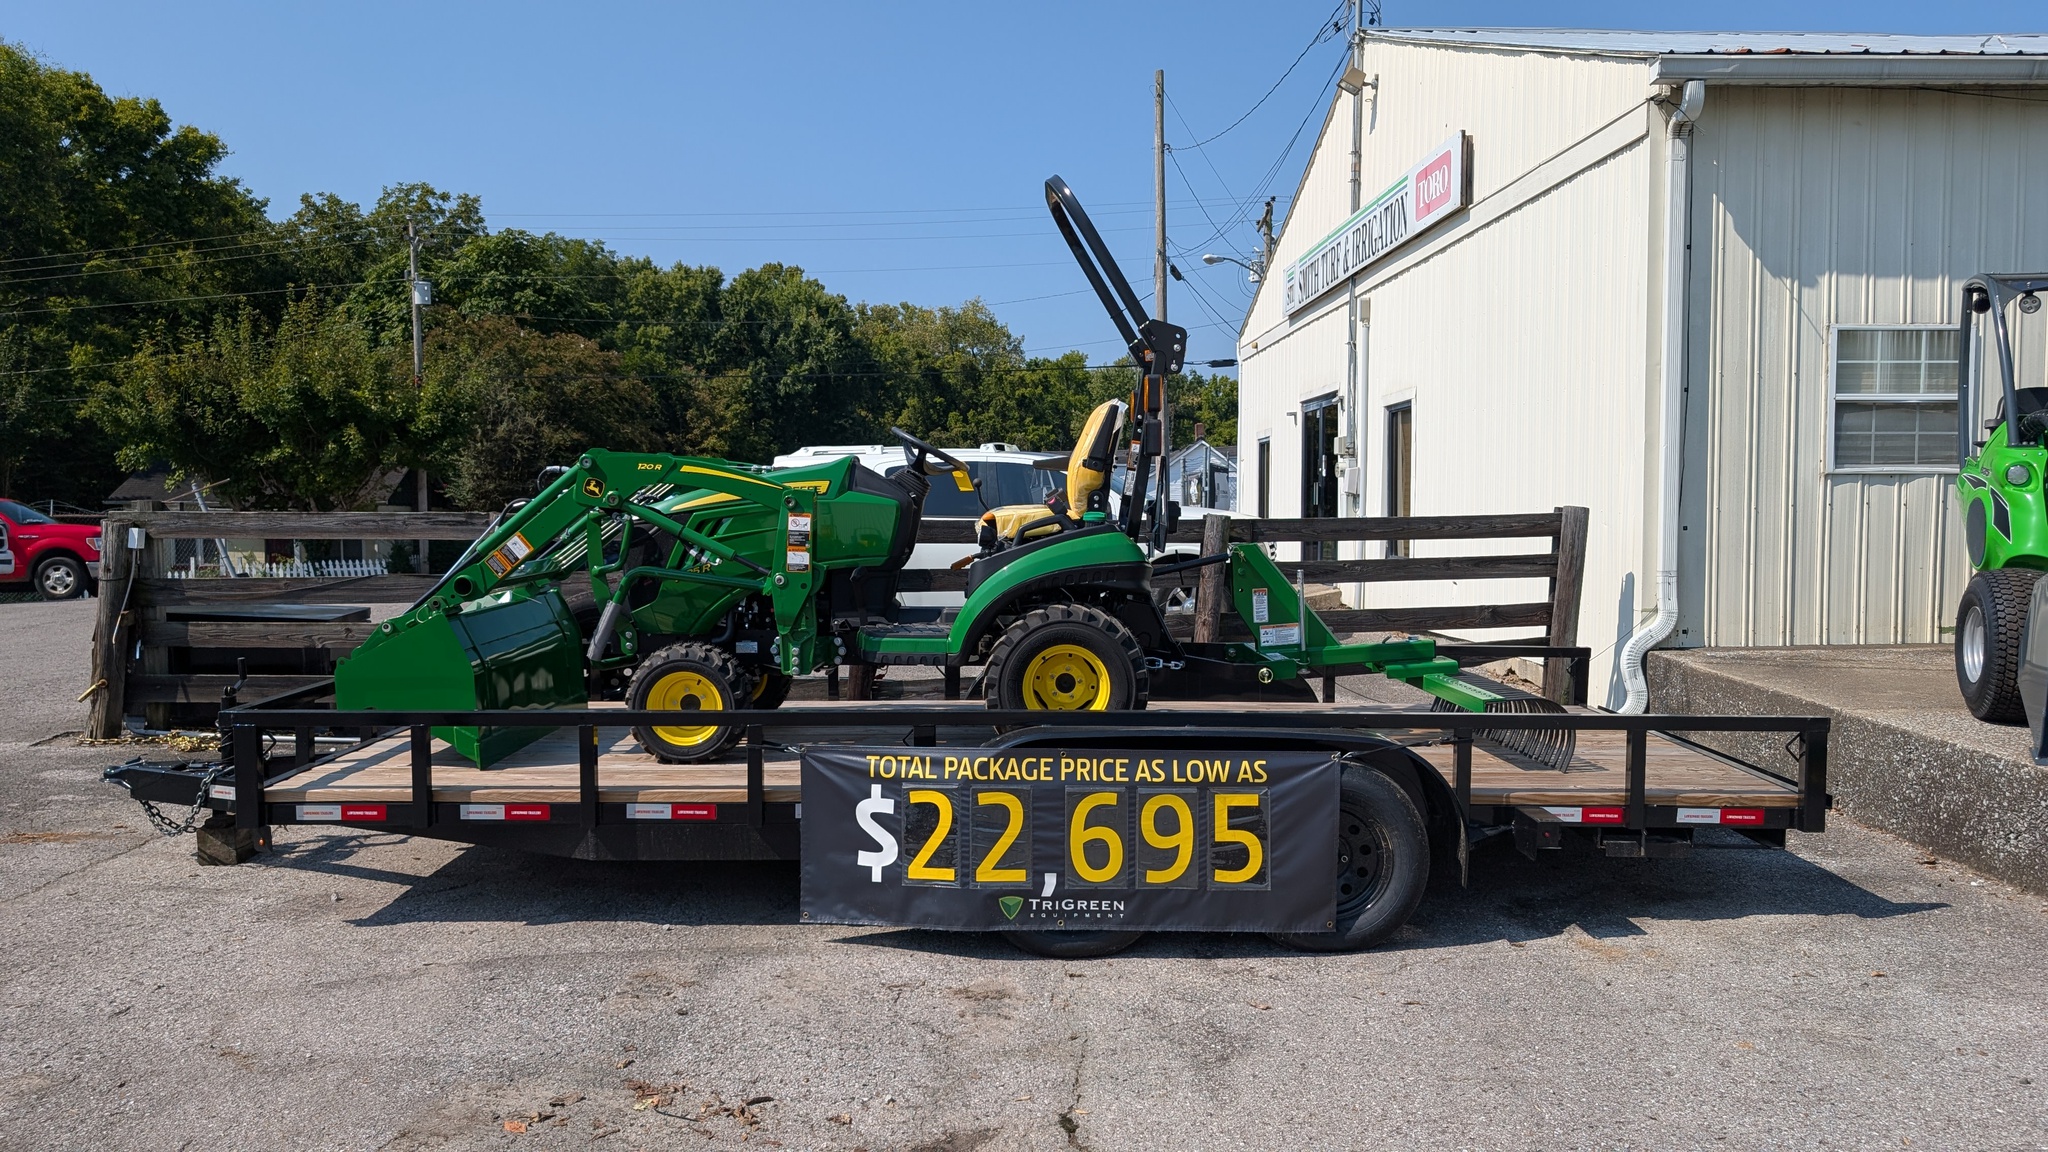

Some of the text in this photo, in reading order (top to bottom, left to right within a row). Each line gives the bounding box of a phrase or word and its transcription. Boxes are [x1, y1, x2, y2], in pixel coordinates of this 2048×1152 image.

[1418, 164, 1449, 209] TORO
[1298, 191, 1408, 304] SMITH TURF & IRRIGATION
[866, 755, 1268, 783] TOTAL PACKAGE PRICE AS LOW AS
[855, 783, 1263, 897] $22,695
